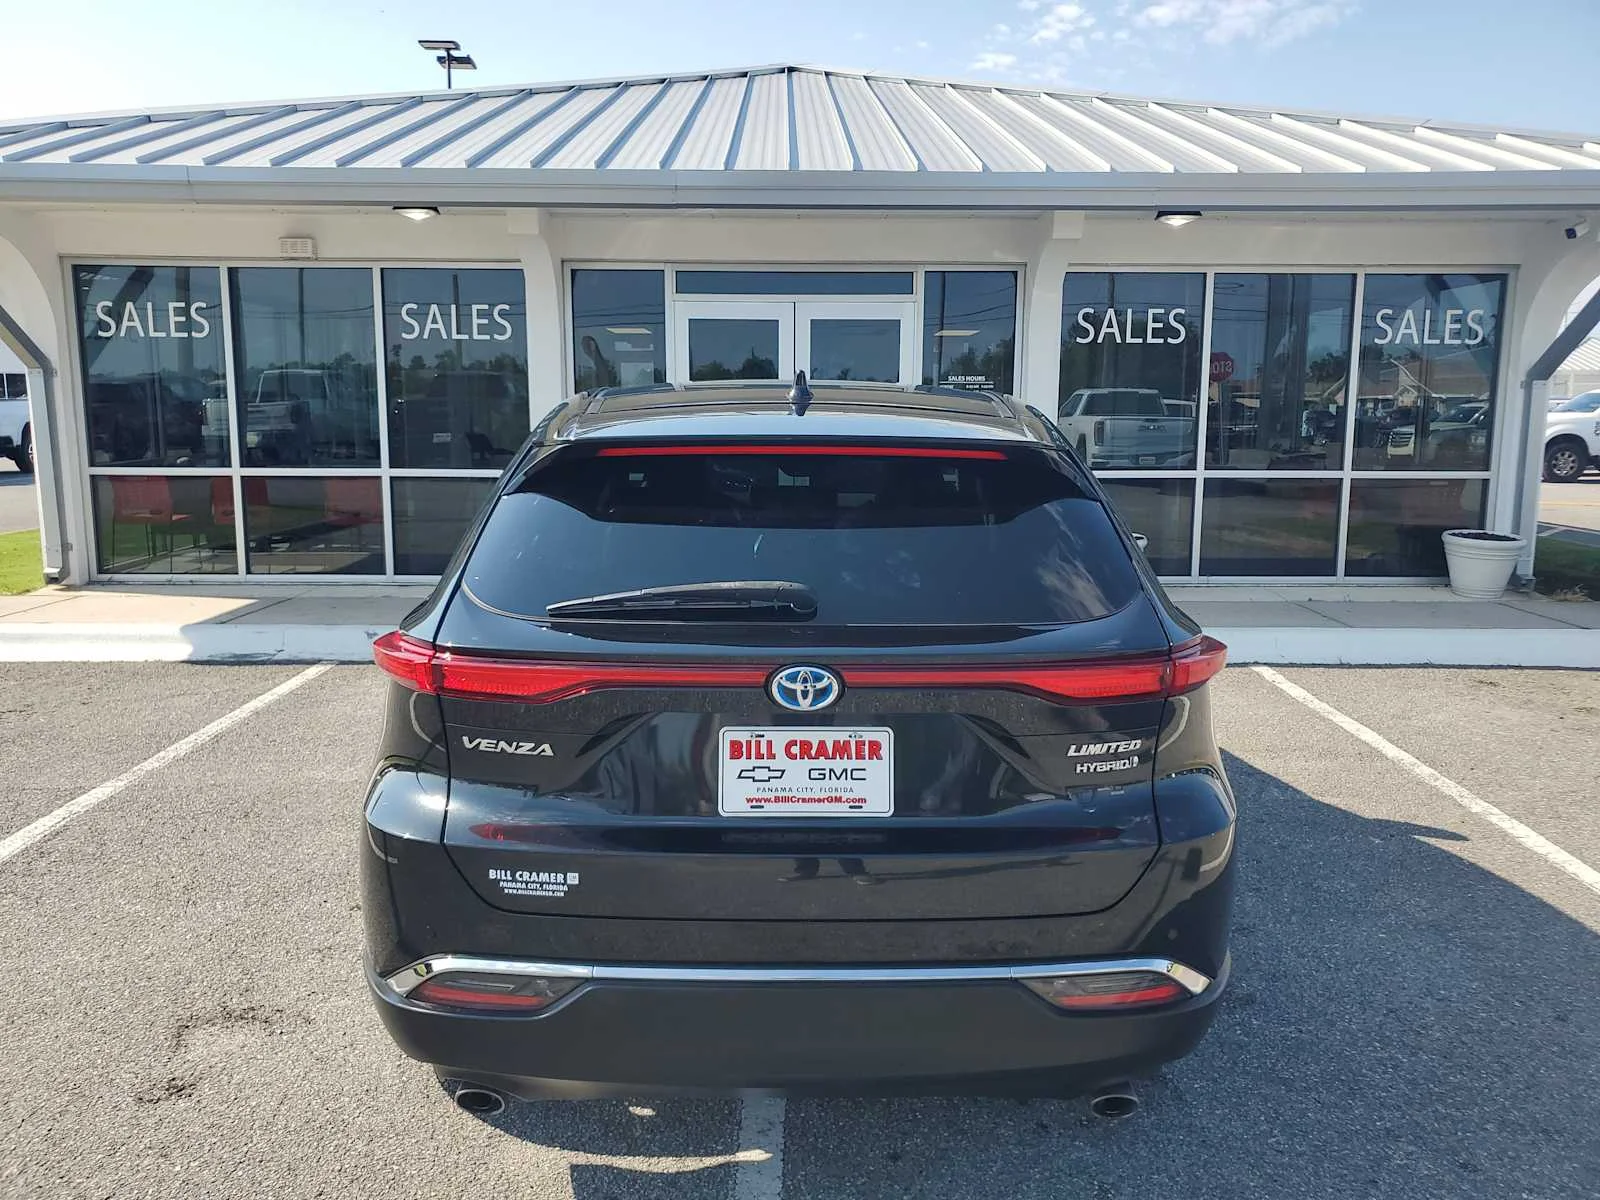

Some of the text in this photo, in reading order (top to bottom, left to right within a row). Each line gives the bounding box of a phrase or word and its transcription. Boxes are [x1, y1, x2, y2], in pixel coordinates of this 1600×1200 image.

[96, 300, 210, 338] SALES
[401, 303, 512, 340] SALES
[1076, 307, 1186, 344] SALES
[1374, 308, 1484, 345] SALES
[462, 735, 554, 757] VENZA
[729, 740, 883, 760] BILL CRAMER
[1067, 739, 1142, 757] LIMITED
[808, 768, 867, 781] GMC
[1076, 759, 1131, 774] HYBRID
[796, 786, 816, 794] CITY,
[745, 795, 867, 804] www.BillCramerGM.com
[488, 869, 512, 880] BILL
[515, 870, 564, 883] CRAMER
[500, 881, 526, 889] PANAMA
